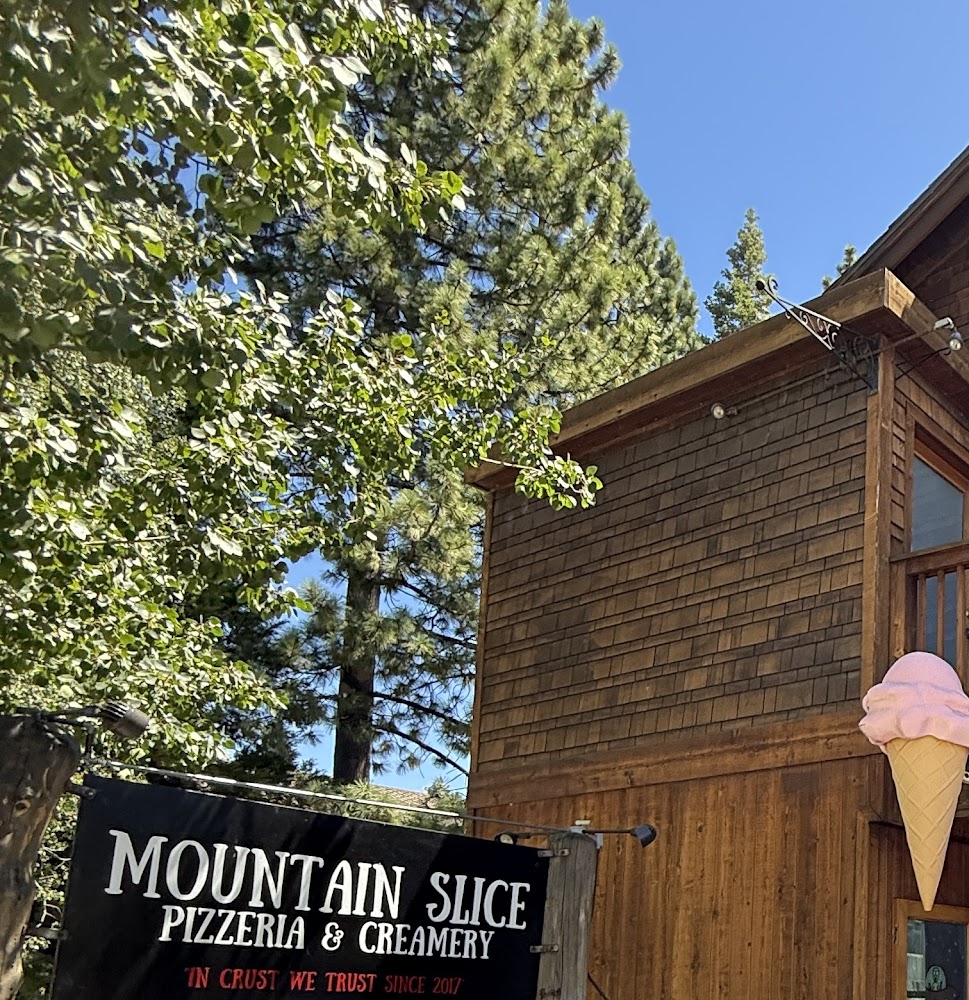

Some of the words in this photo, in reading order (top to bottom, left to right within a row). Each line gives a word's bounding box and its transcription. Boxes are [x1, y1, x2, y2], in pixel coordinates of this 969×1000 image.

[104, 829, 405, 919] MOUNTAIN
[426, 871, 531, 930] SLICE
[158, 905, 305, 950] PIZZERIA
[321, 922, 344, 951] &
[358, 921, 496, 960] CREAMERY
[219, 968, 281, 991] CRUST
[290, 971, 318, 992] WE
[325, 972, 378, 993] TRUST
[385, 975, 426, 995] SINCE
